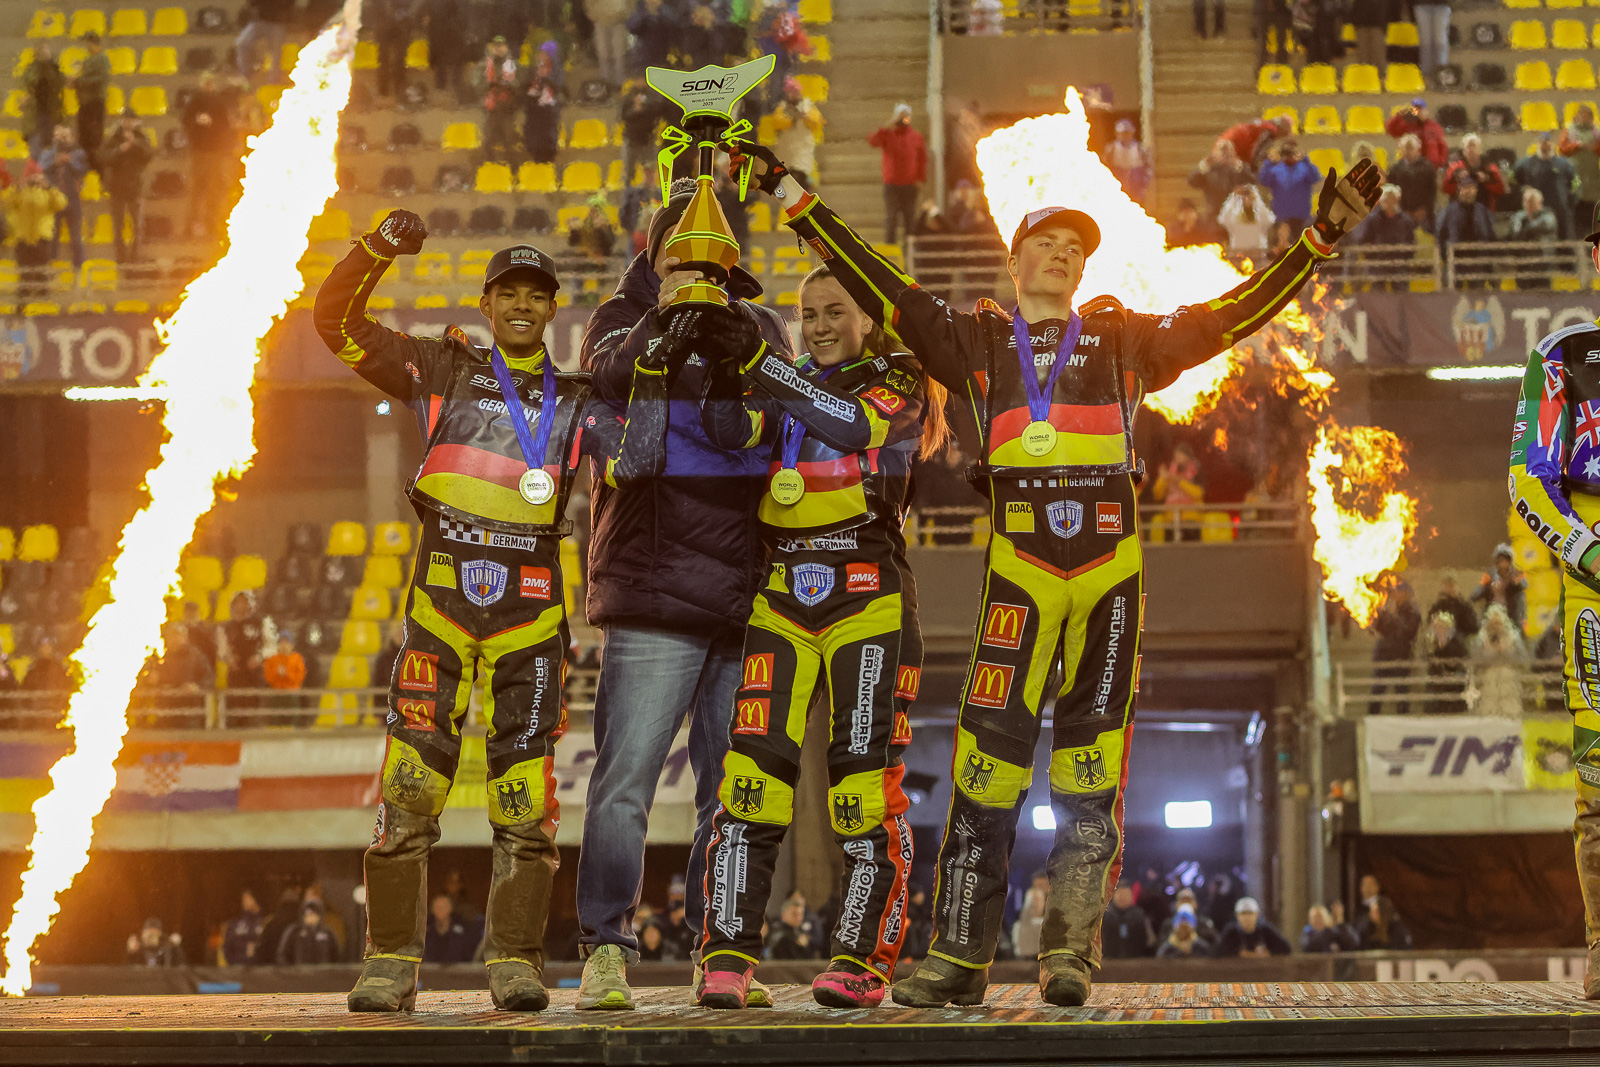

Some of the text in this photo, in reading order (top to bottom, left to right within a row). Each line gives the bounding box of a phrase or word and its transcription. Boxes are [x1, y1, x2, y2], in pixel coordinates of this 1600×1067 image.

[680, 73, 738, 94] SON2
[761, 362, 856, 416] BRUNKHORST
[1069, 477, 1105, 487] GERMANY
[1008, 503, 1033, 514] ADAC
[1098, 514, 1120, 524] DMV
[1515, 499, 1562, 552] BOLL
[492, 534, 535, 550] GERMANY
[813, 540, 855, 550] GERMANY
[430, 553, 454, 567] ADA
[469, 568, 501, 587] ADMV
[522, 577, 549, 588] DMV
[848, 573, 877, 584] DMV
[1095, 595, 1121, 715] BRUNKHORST
[856, 647, 875, 752] BRUNKHORST
[737, 855, 746, 890] Insurance
[713, 881, 726, 911] Jörg
[959, 871, 978, 945] Grohmann
